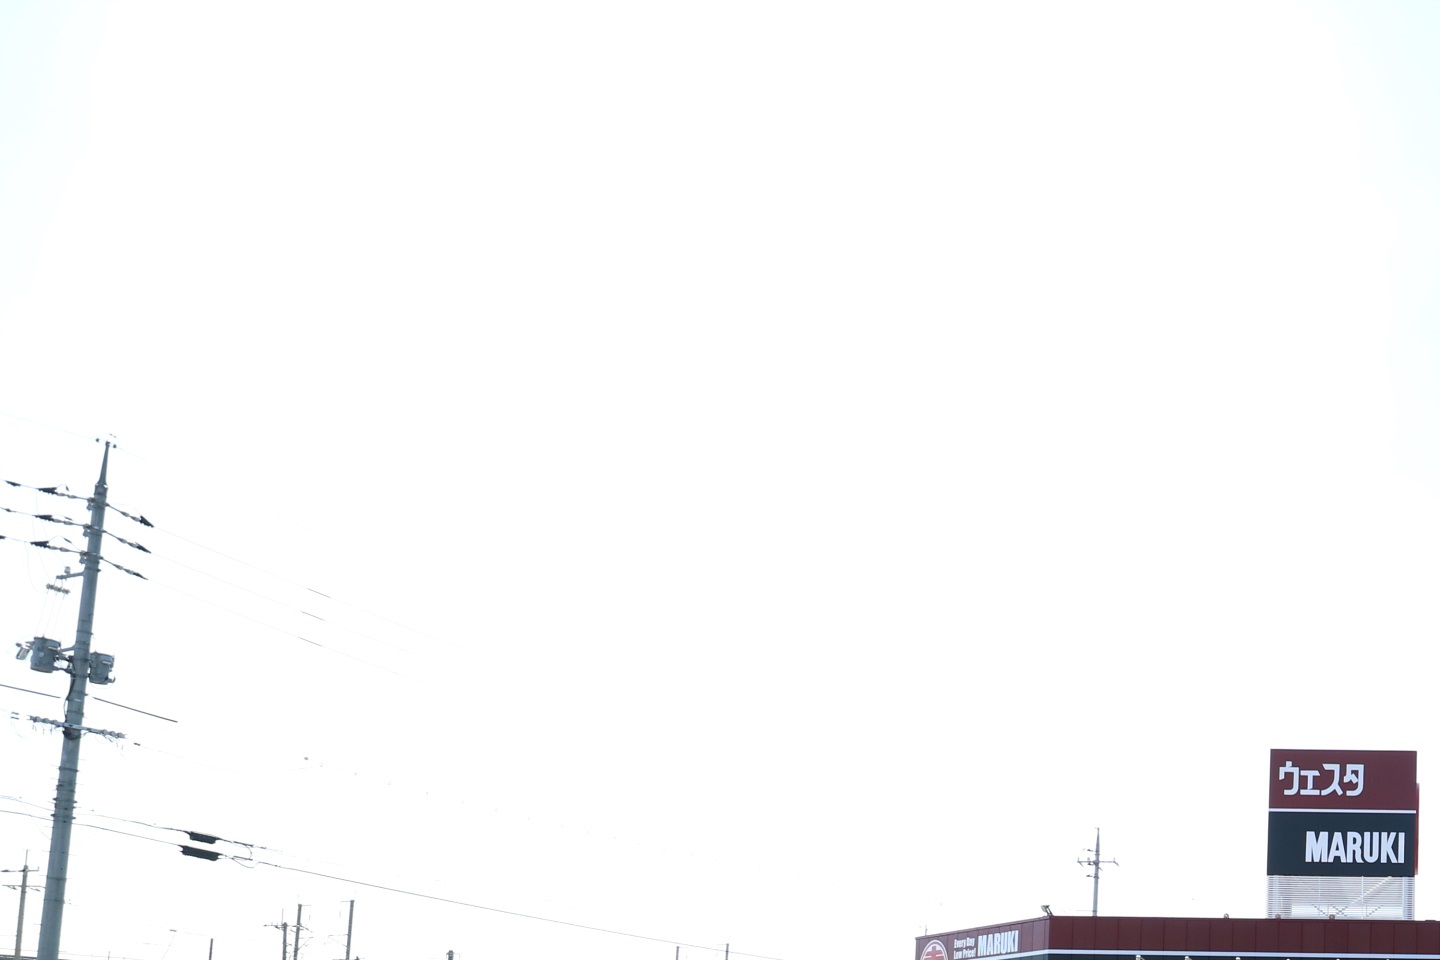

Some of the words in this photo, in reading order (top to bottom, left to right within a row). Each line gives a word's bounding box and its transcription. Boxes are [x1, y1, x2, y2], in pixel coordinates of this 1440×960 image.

[1279, 761, 1364, 796] ウェスタ
[1305, 831, 1405, 863] MARUKI
[953, 950, 963, 960] Low
[954, 938, 966, 949] Every
[977, 930, 1019, 957] MARUKI
